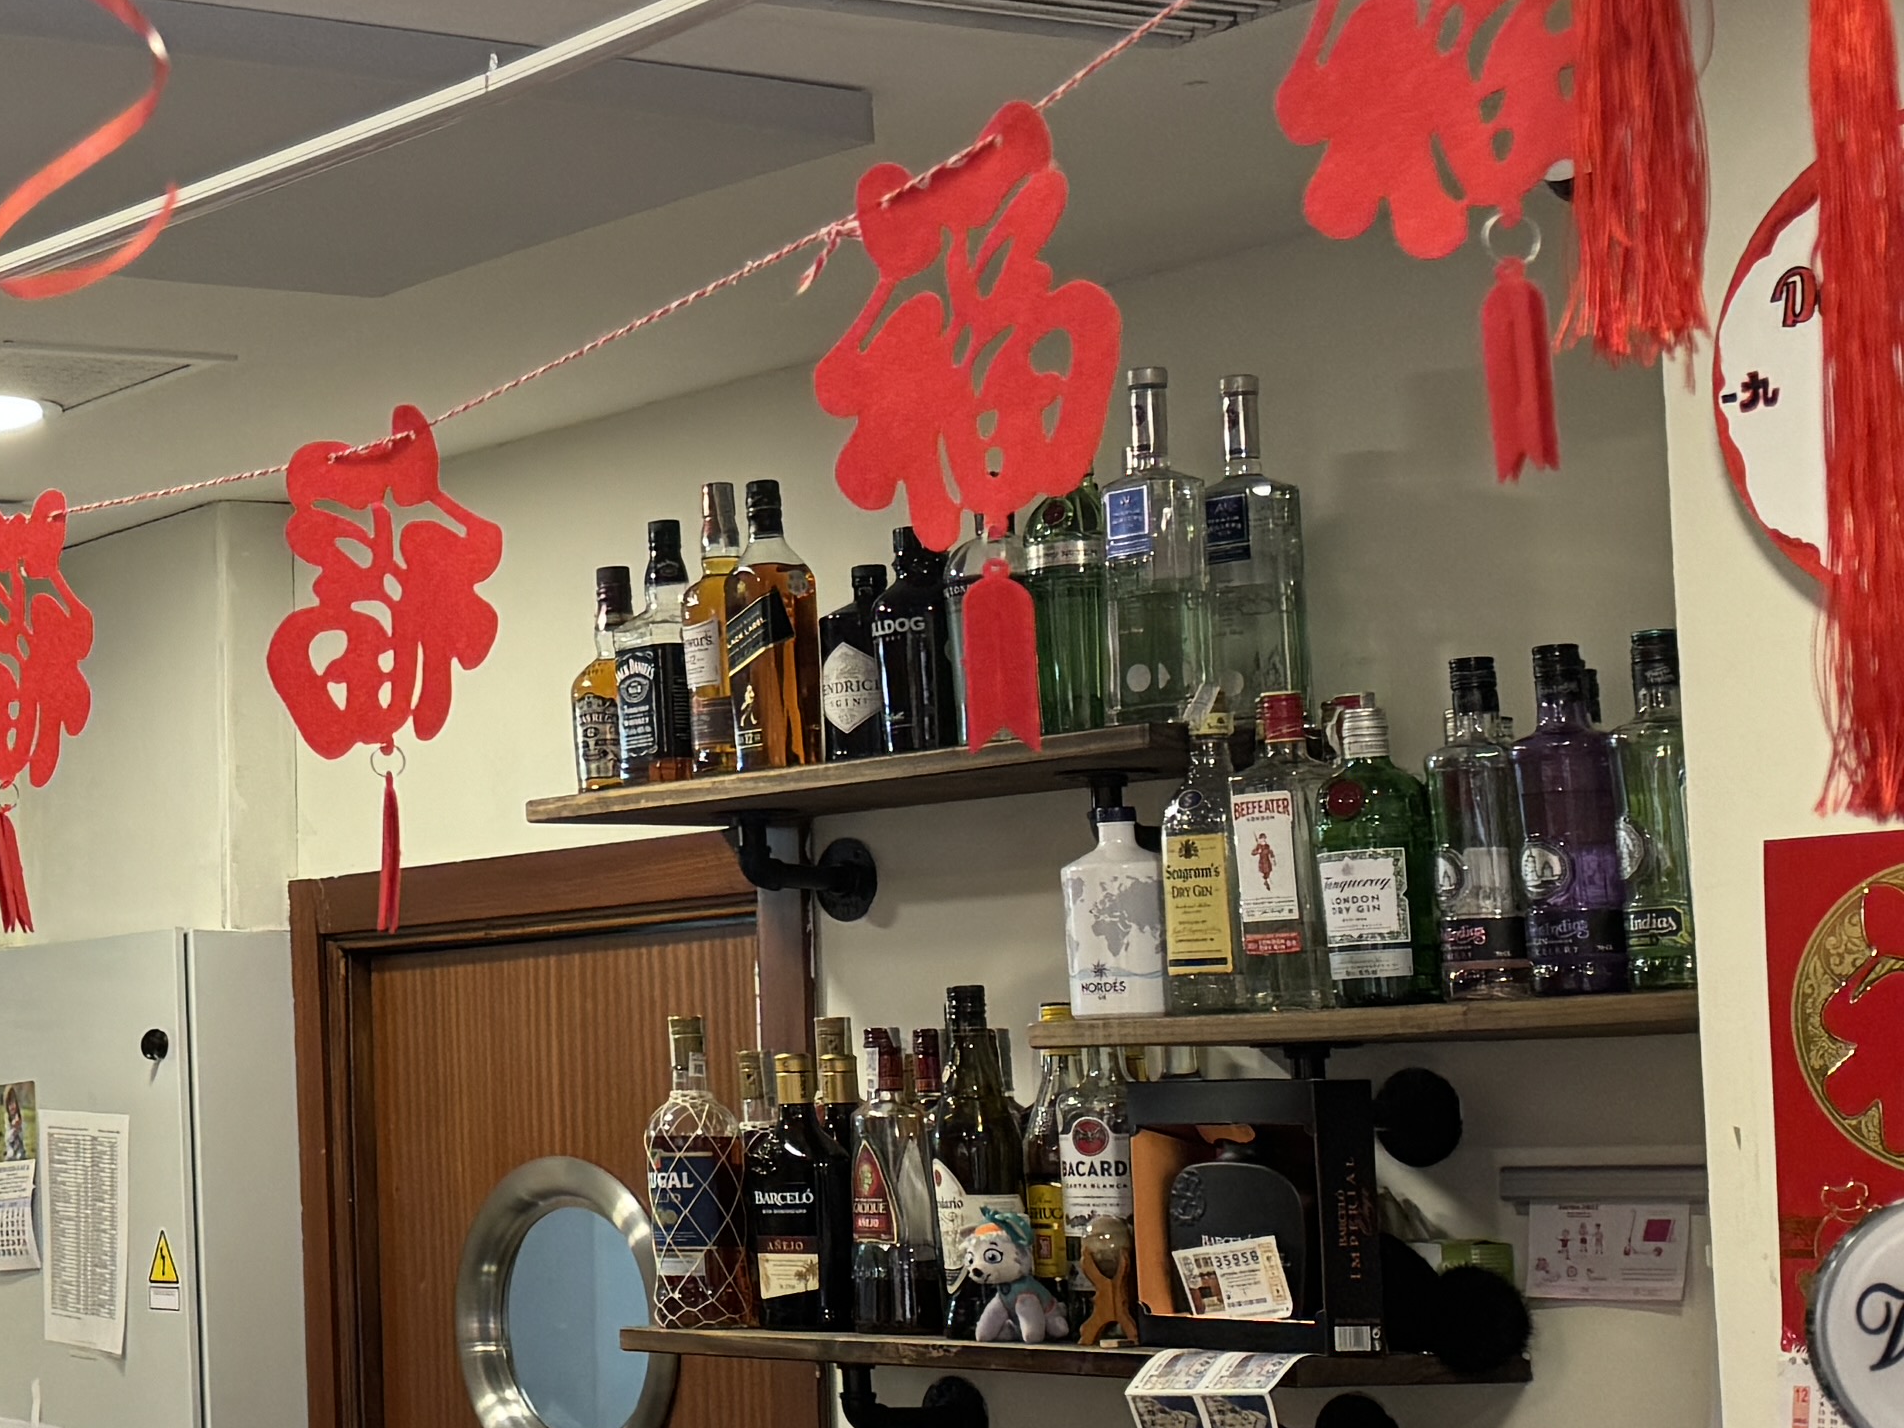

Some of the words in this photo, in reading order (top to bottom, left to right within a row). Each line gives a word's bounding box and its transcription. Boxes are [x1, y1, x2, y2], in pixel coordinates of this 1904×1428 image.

[1233, 797, 1290, 821] BEEFEATER
[1246, 814, 1275, 822] LONDON
[1165, 862, 1221, 881] Seagram's
[1171, 884, 1191, 899] DRY
[1322, 875, 1392, 893] Tanqueray
[1331, 894, 1381, 907] LONDON
[1331, 905, 1353, 915] DRY
[1357, 902, 1381, 914] GIN
[1629, 913, 1678, 933] Indias
[1081, 979, 1126, 994] NORDÉS
[754, 1188, 815, 1206] BARCELÓ
[1345, 1157, 1361, 1279] IMPERIAL
[767, 1239, 805, 1252] AÑEJO
[1215, 1250, 1260, 1269] 35958
[1795, 1388, 1809, 1403] 12
